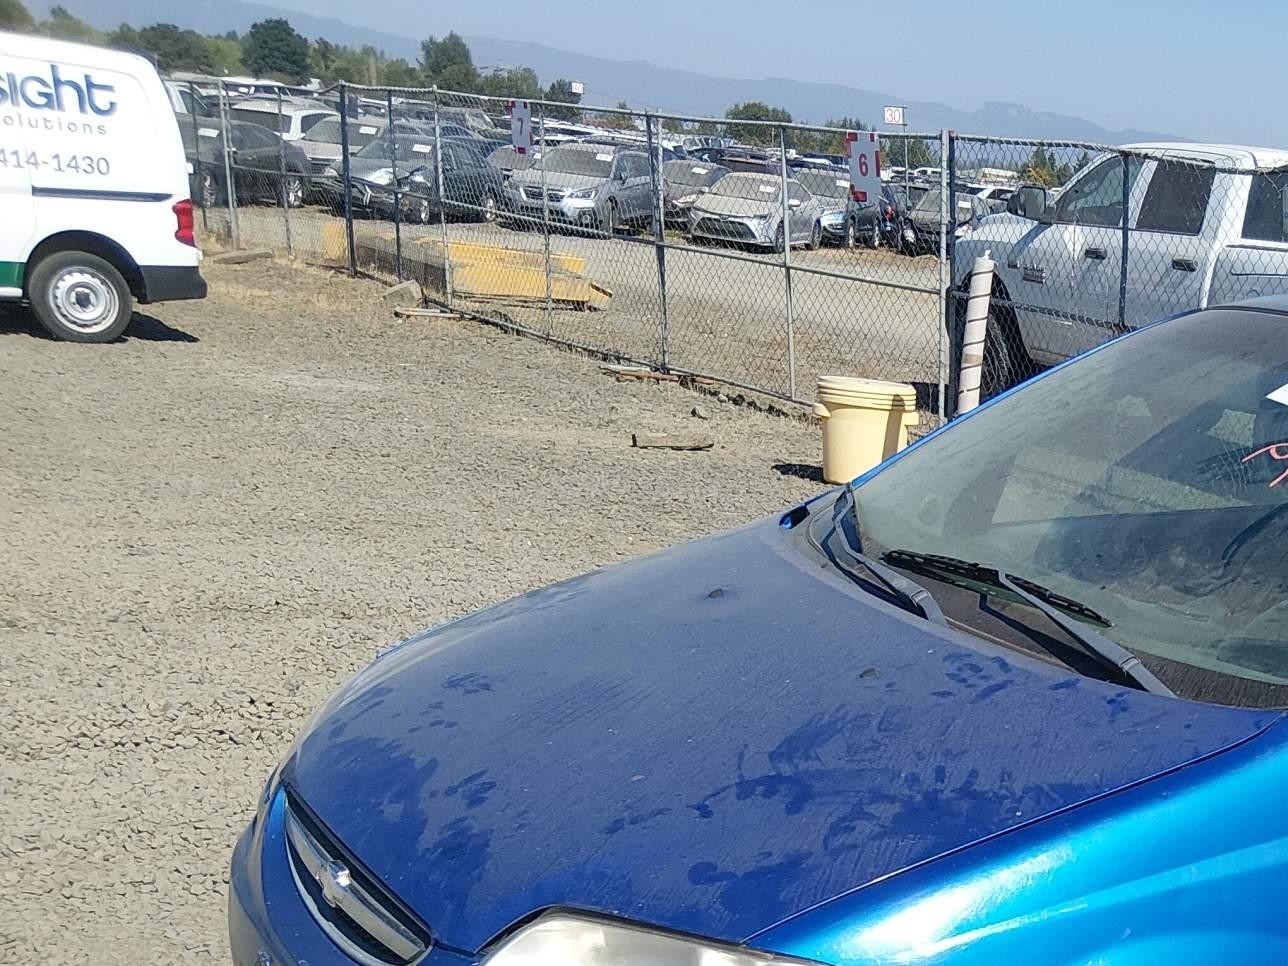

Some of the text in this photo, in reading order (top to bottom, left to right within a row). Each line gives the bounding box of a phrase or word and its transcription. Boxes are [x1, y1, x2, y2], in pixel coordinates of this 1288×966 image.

[2, 113, 107, 135] olutions
[886, 108, 901, 123] 30
[859, 153, 869, 177] 6
